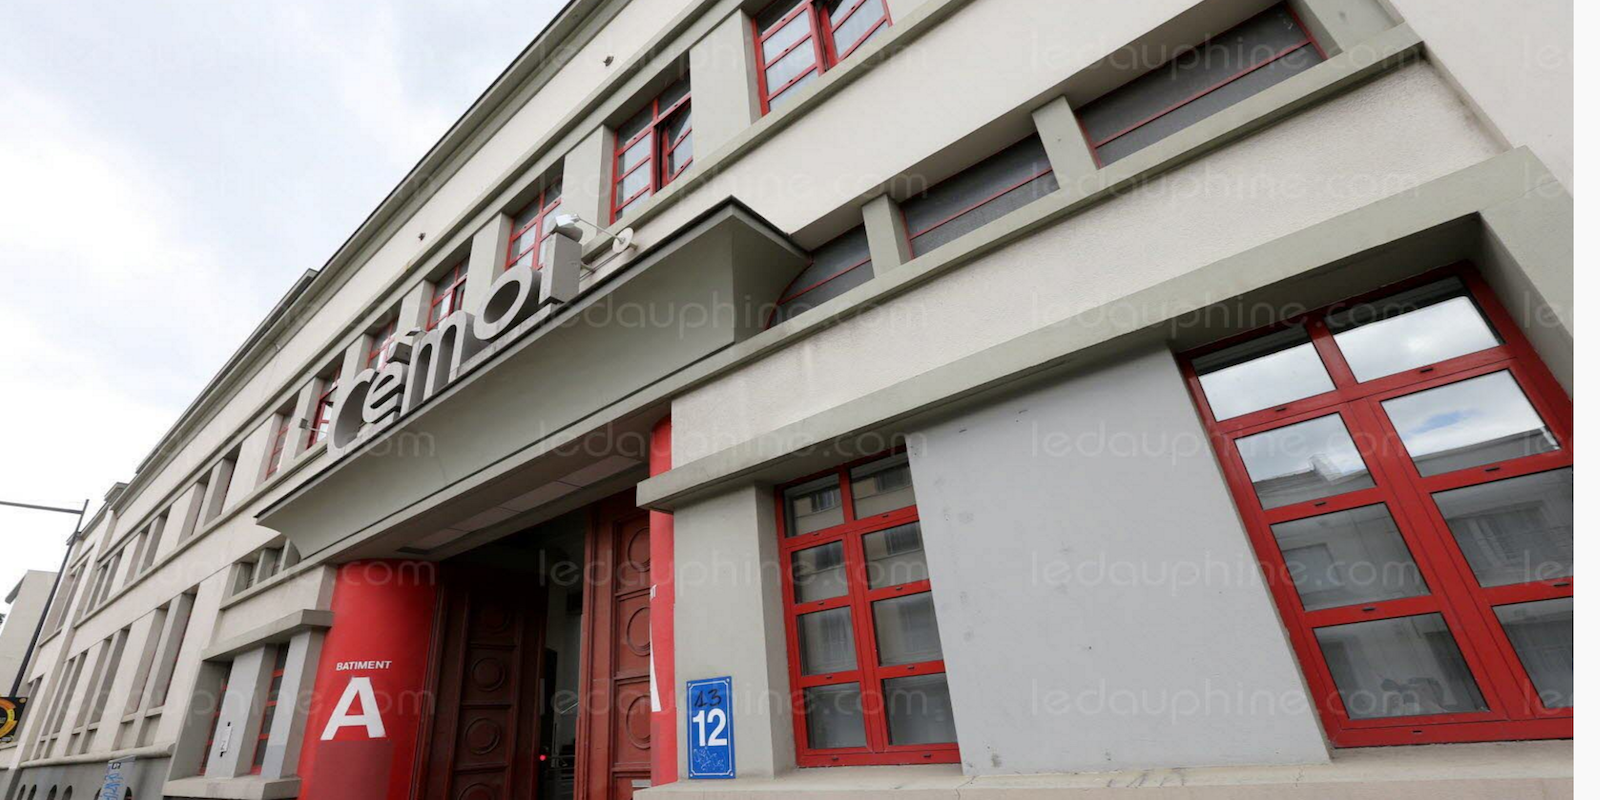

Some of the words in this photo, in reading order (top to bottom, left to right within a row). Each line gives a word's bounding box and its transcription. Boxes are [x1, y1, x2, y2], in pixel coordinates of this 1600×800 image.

[336, 660, 392, 671] BATIMENT
[320, 676, 387, 741] A
[692, 708, 728, 747] 12
